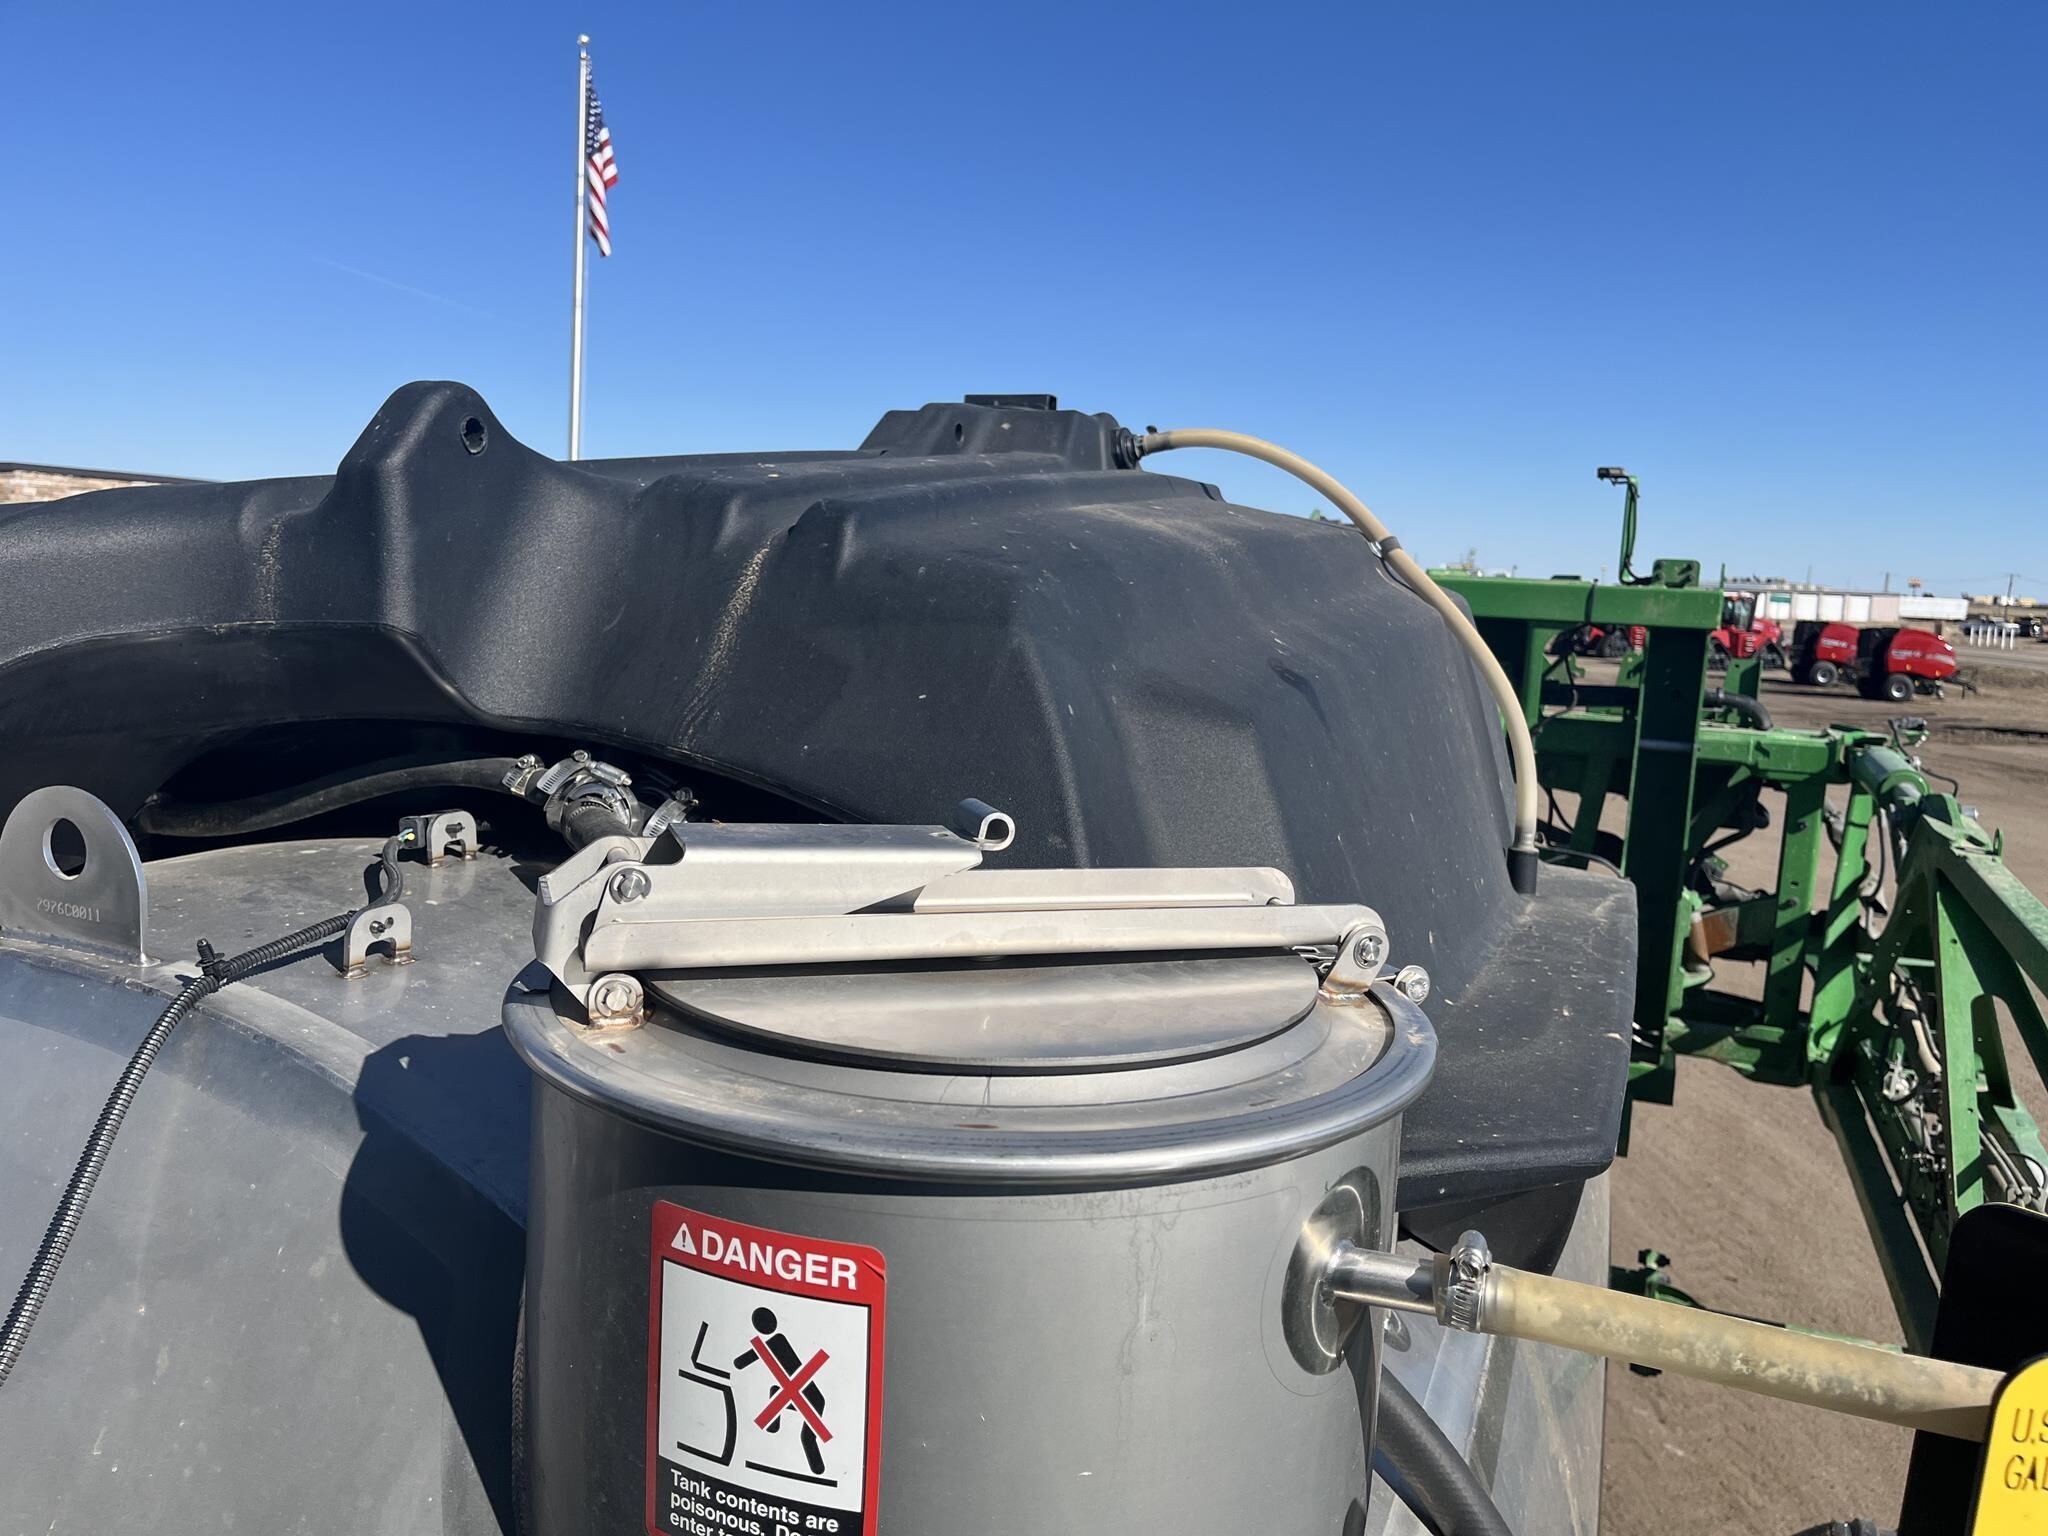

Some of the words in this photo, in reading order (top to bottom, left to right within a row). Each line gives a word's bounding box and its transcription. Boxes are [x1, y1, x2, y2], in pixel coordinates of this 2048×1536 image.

[702, 1229, 857, 1290] DANGER
[670, 1468, 711, 1500] Tank
[715, 1490, 800, 1525] contents
[805, 1514, 839, 1533] are
[670, 1512, 714, 1536] enter
